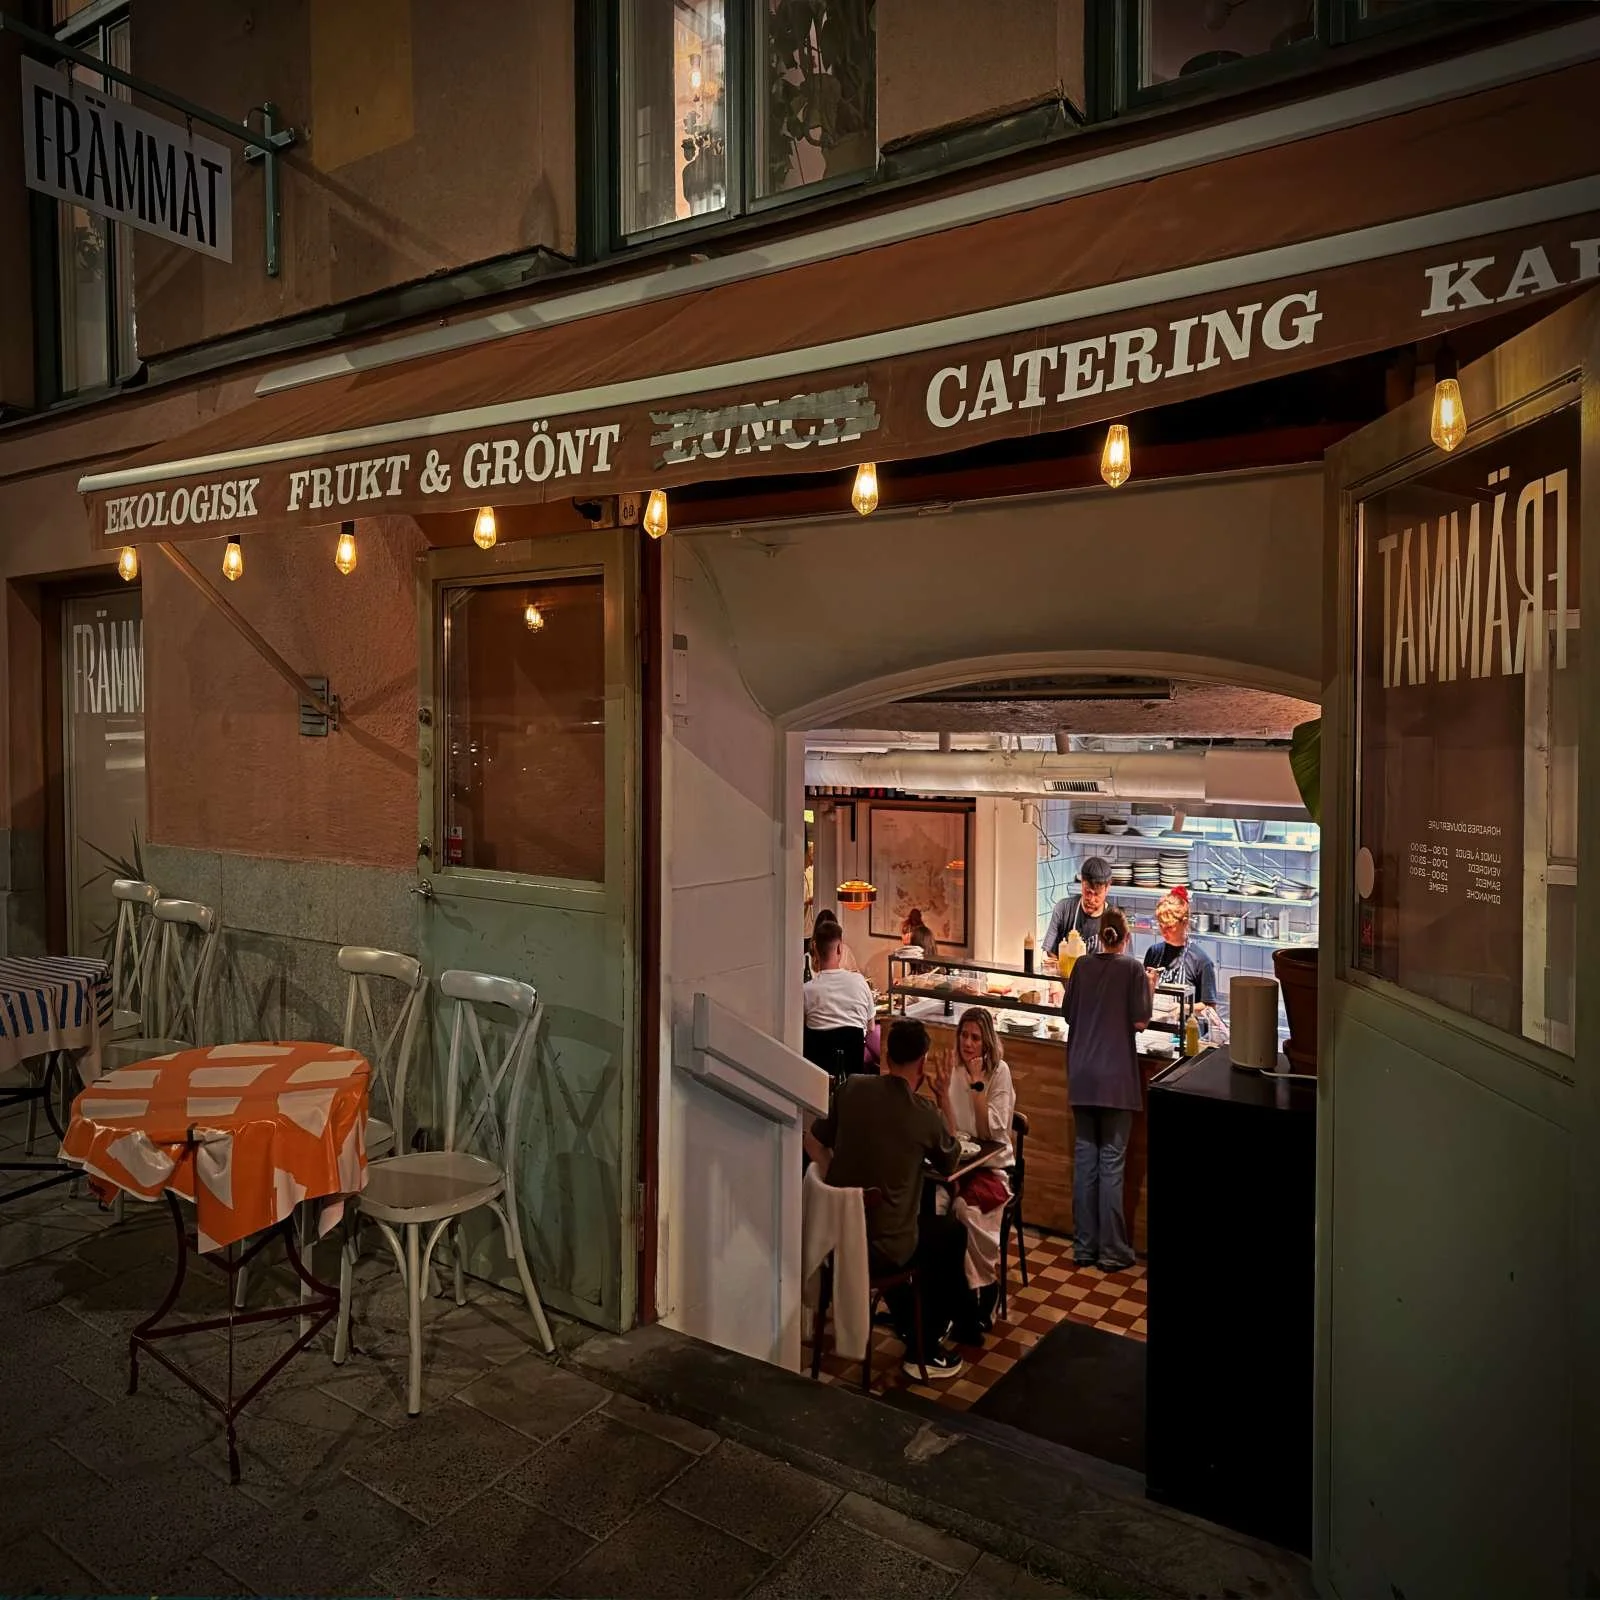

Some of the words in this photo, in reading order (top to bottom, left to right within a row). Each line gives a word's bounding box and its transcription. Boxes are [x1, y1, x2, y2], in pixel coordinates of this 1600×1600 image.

[34, 85, 222, 247] FRÄMMAT
[105, 479, 260, 535] EKOLOGISK
[287, 454, 409, 511] FRUKT
[420, 449, 452, 494] &
[462, 420, 620, 489] GRÖNT
[925, 290, 1323, 428] CATERING
